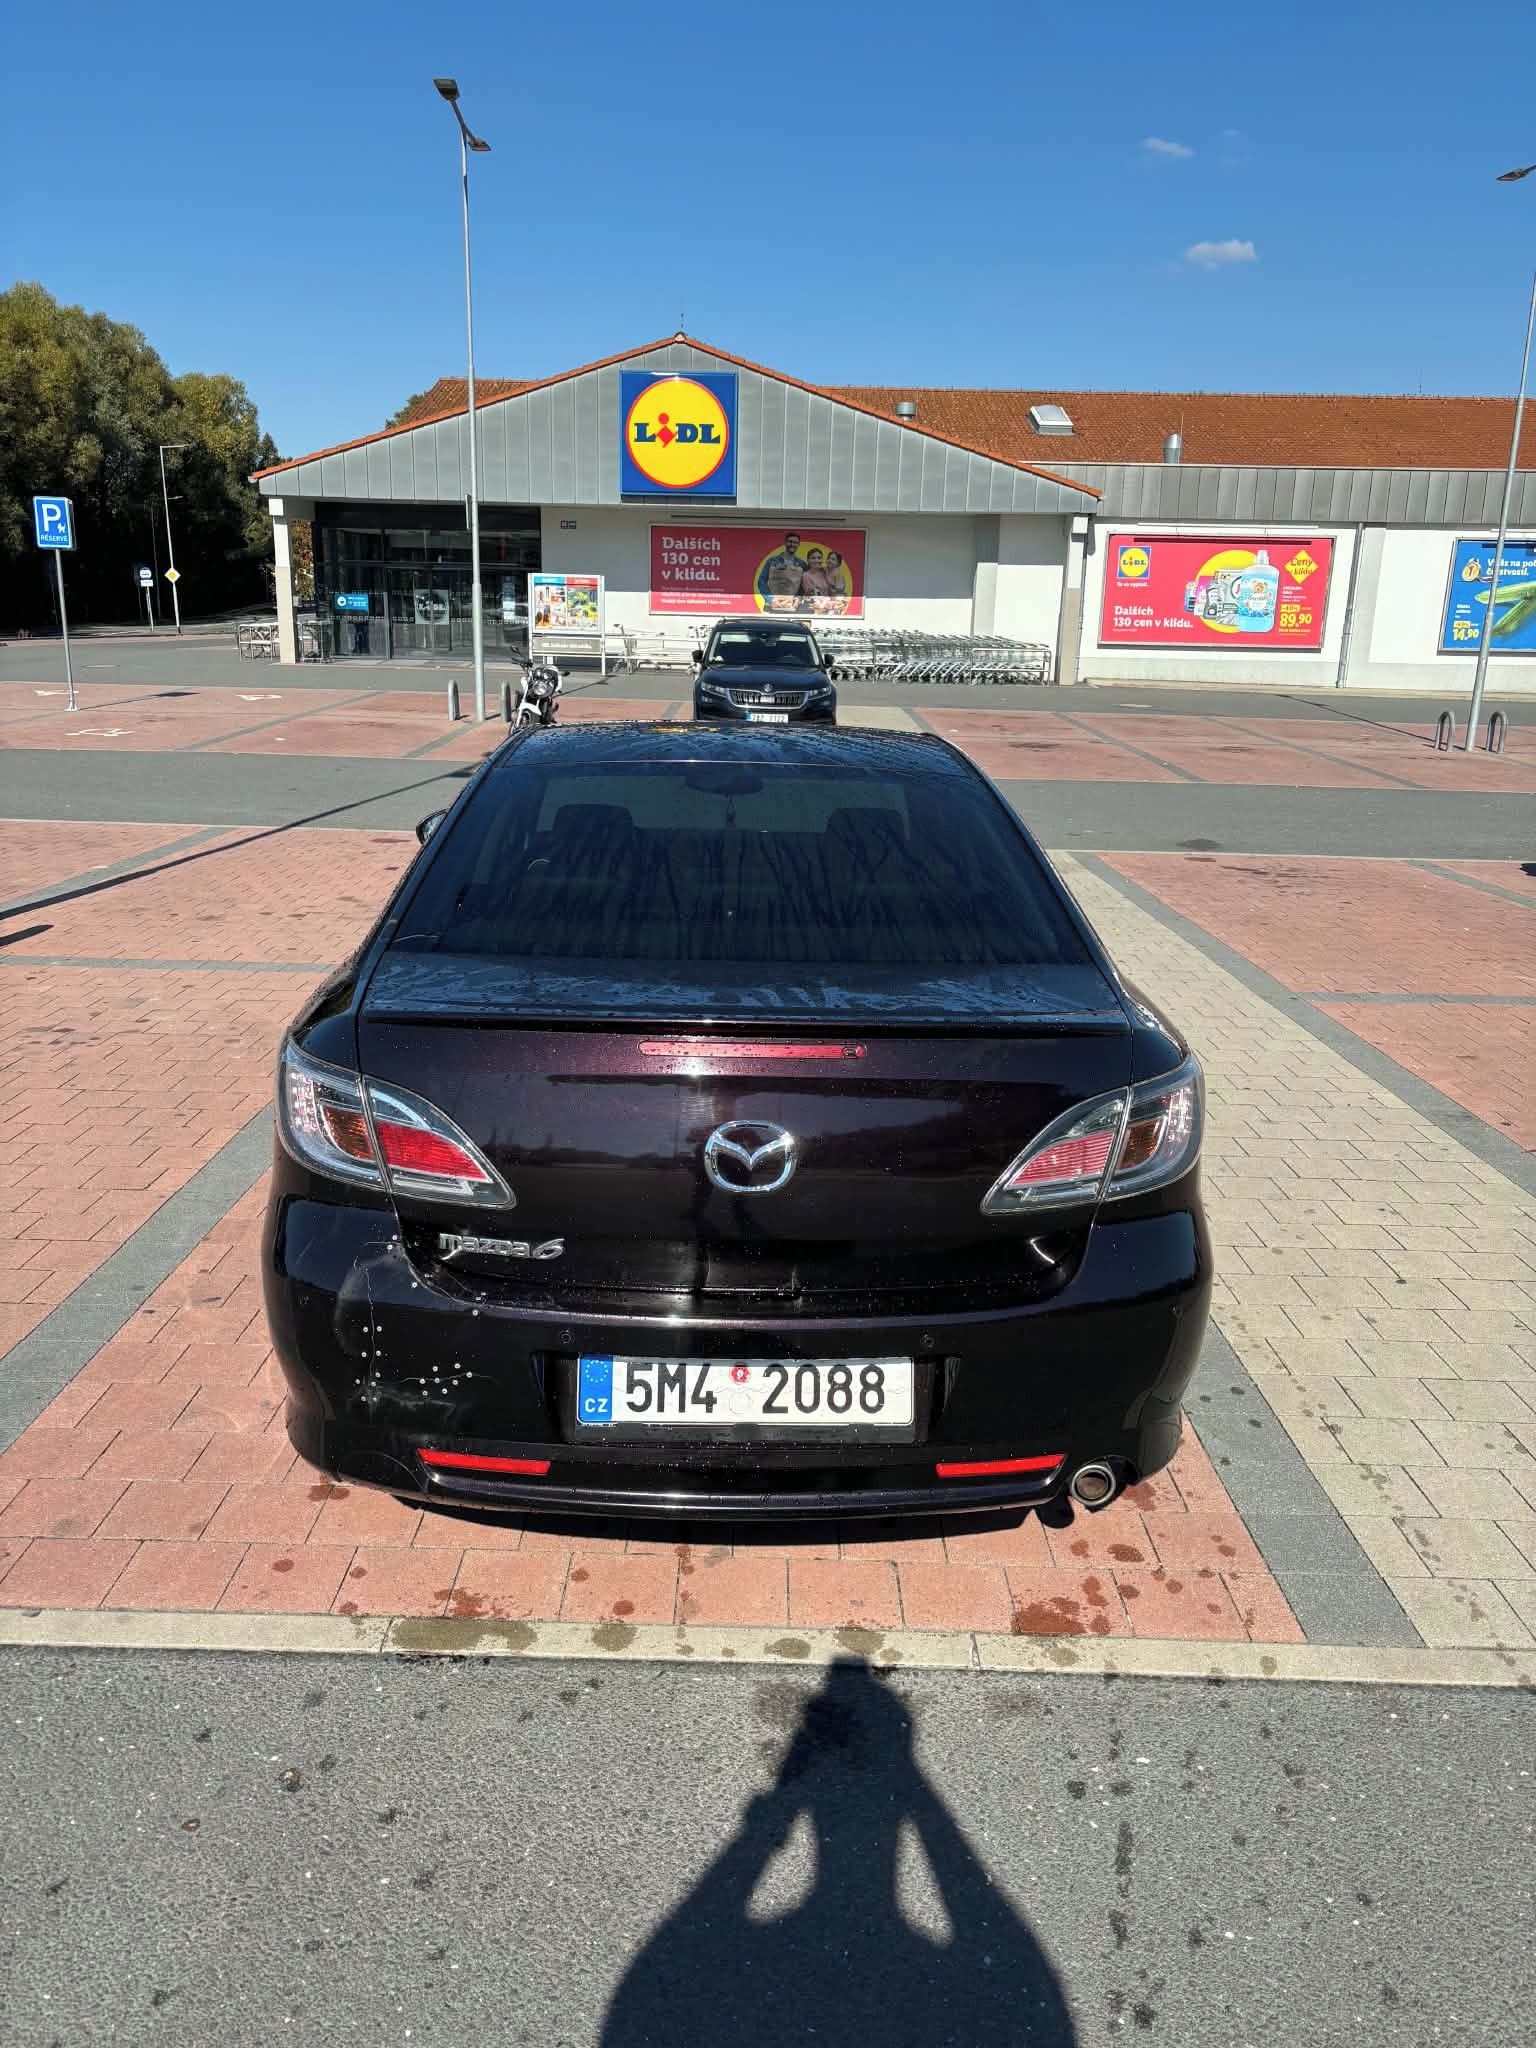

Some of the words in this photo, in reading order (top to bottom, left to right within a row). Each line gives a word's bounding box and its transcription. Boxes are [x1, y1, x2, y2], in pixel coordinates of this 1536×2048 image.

[41, 503, 61, 532] P
[662, 536, 721, 551] Dalších
[662, 552, 687, 566] 130
[692, 554, 721, 567] cen
[661, 570, 672, 581] v
[674, 567, 720, 582] klidu.
[1114, 605, 1153, 616] Dalších
[1113, 617, 1131, 627] 130
[1133, 619, 1153, 627] cen
[626, 1362, 718, 1414] 5M4
[762, 1363, 886, 1415] 2088
[584, 1398, 608, 1413] CZ
